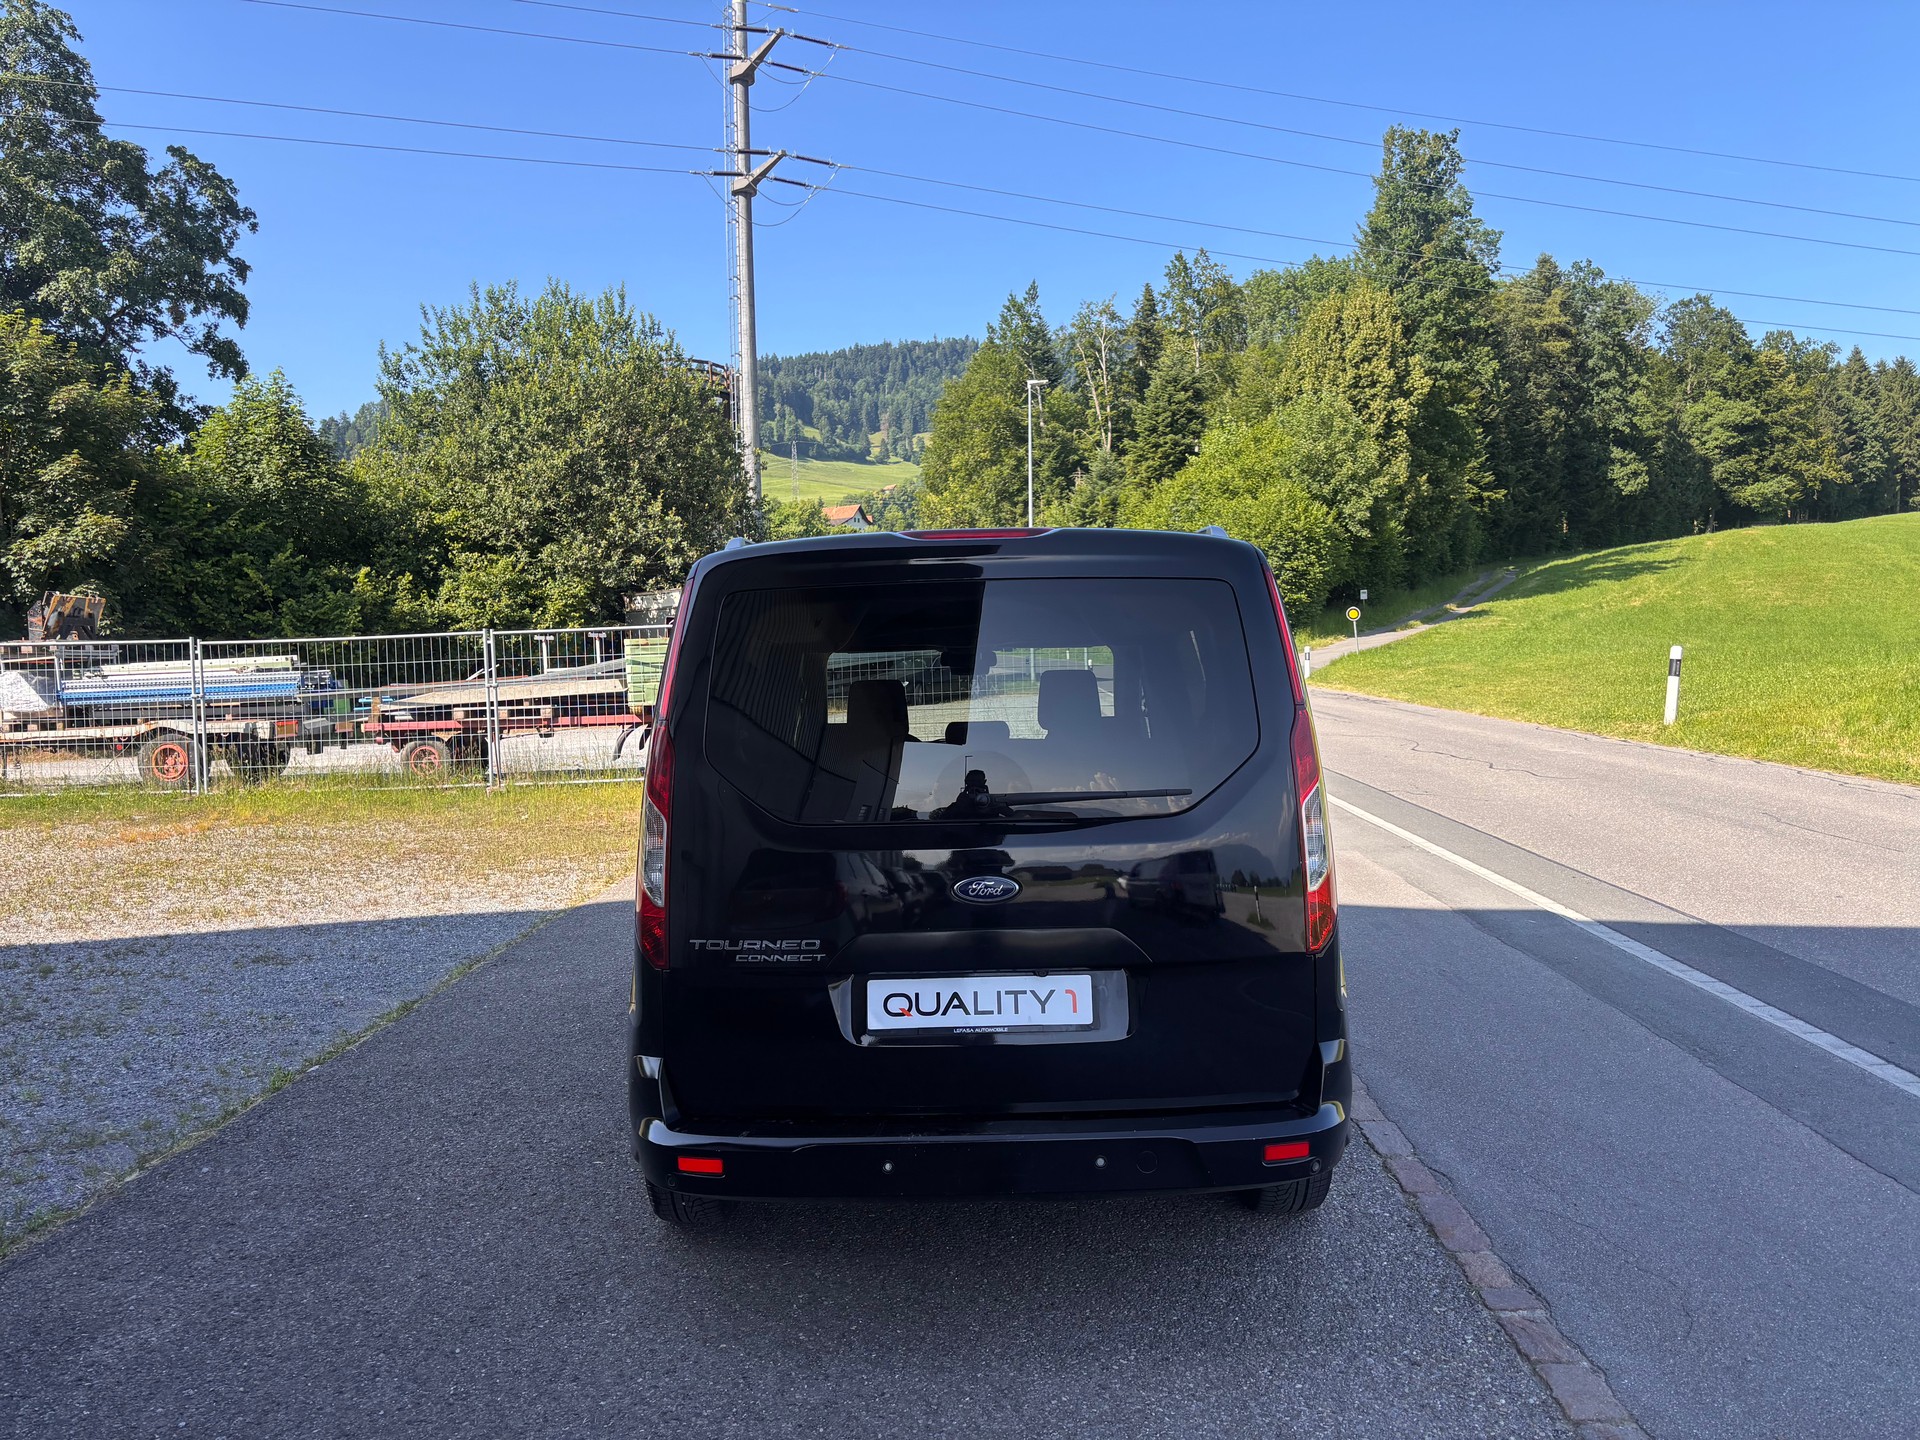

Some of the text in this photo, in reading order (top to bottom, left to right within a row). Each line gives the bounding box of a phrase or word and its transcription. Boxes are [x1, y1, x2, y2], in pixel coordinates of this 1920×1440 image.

[968, 880, 1004, 896] Ford
[689, 939, 821, 951] TOURNEO
[735, 953, 827, 962] CONNECT
[882, 989, 1078, 1017] QUALITY 1
